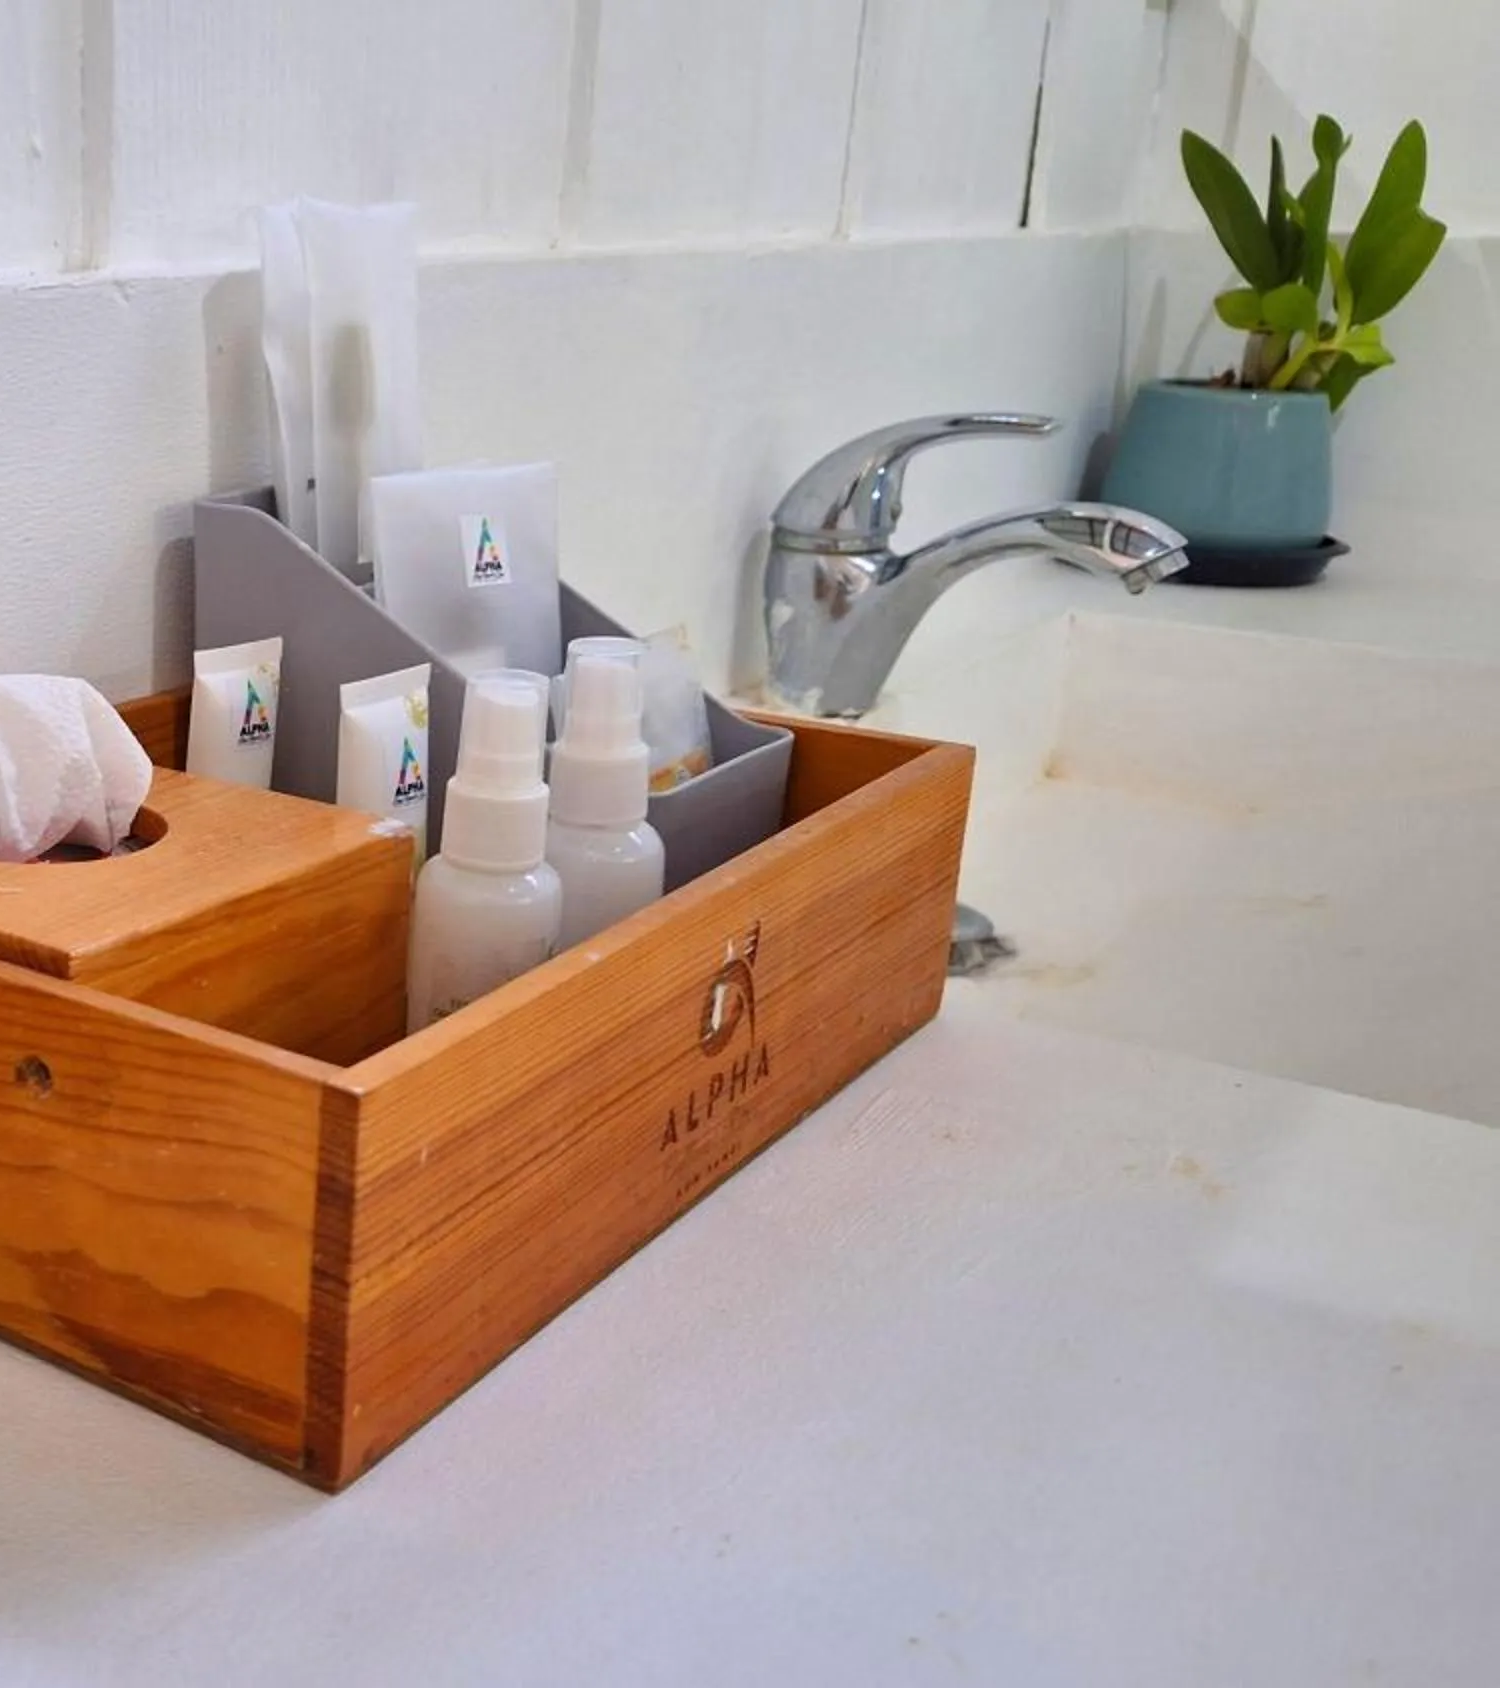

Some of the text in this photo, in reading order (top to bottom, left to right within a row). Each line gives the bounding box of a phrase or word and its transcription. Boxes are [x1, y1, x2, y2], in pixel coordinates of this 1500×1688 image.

[239, 721, 271, 738] ALPHA
[395, 779, 425, 797] ALPHA
[660, 1042, 770, 1151] ALPHA
